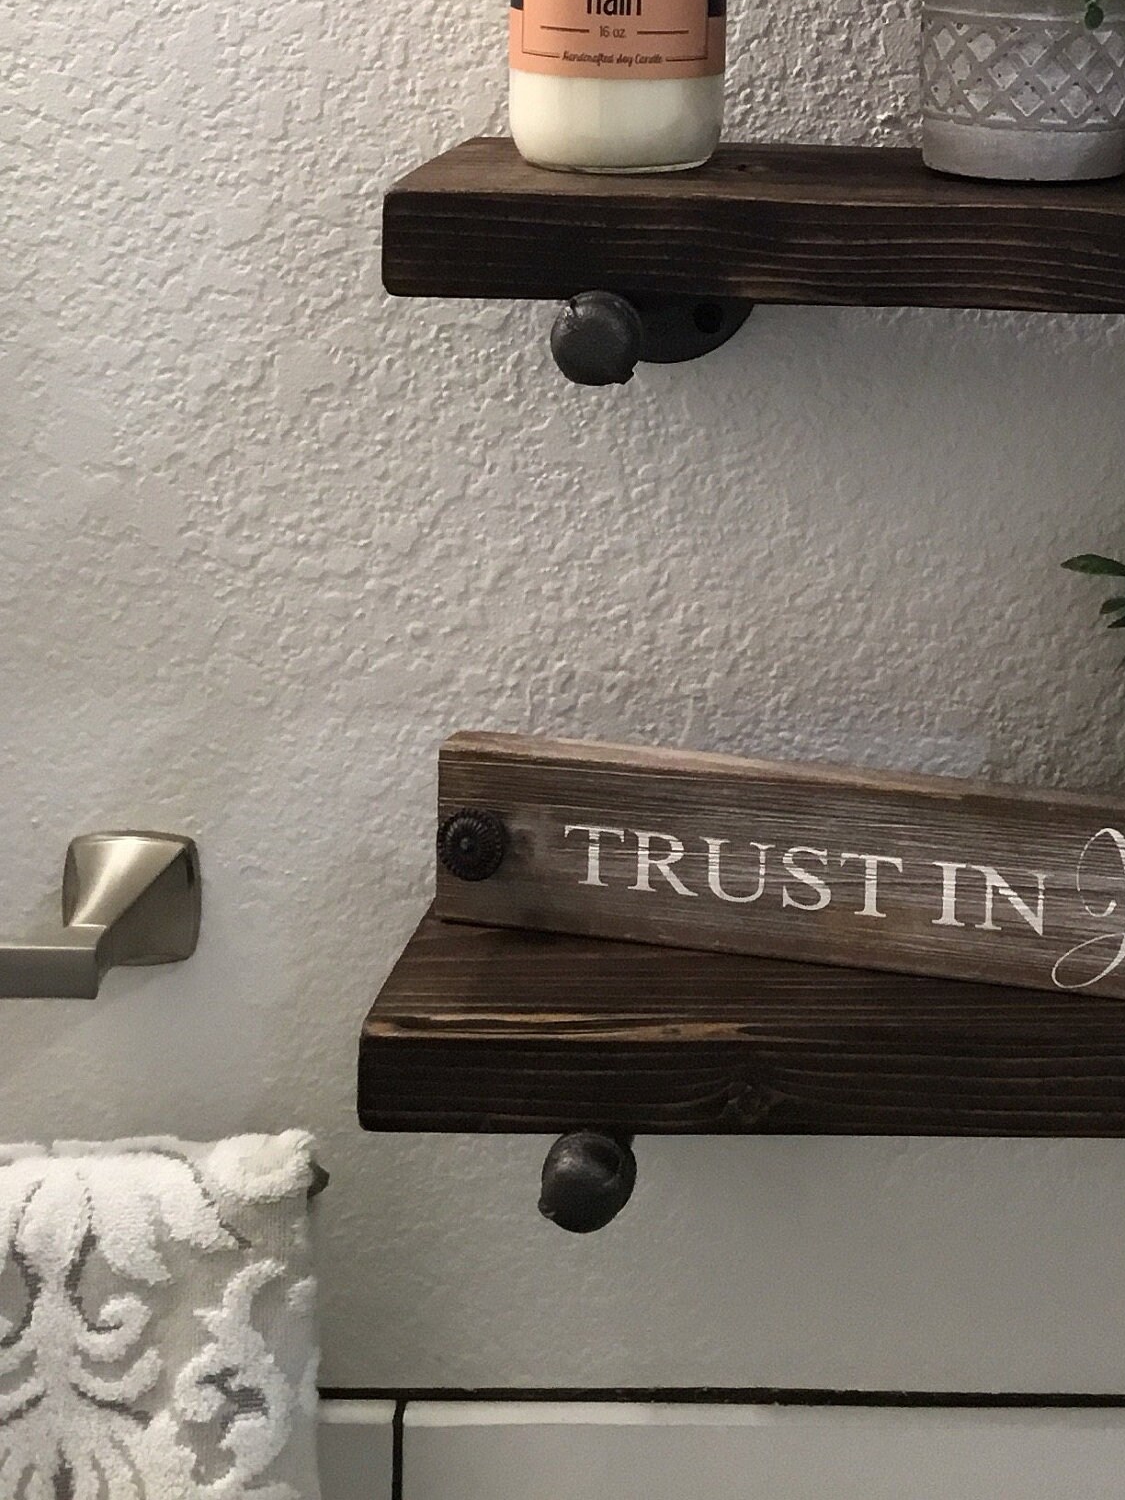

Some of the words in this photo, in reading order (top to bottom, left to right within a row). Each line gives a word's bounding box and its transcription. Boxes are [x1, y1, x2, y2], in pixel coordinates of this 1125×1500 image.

[600, 26, 610, 38] 16
[564, 825, 902, 919] TRUST
[930, 861, 1046, 936] IN
